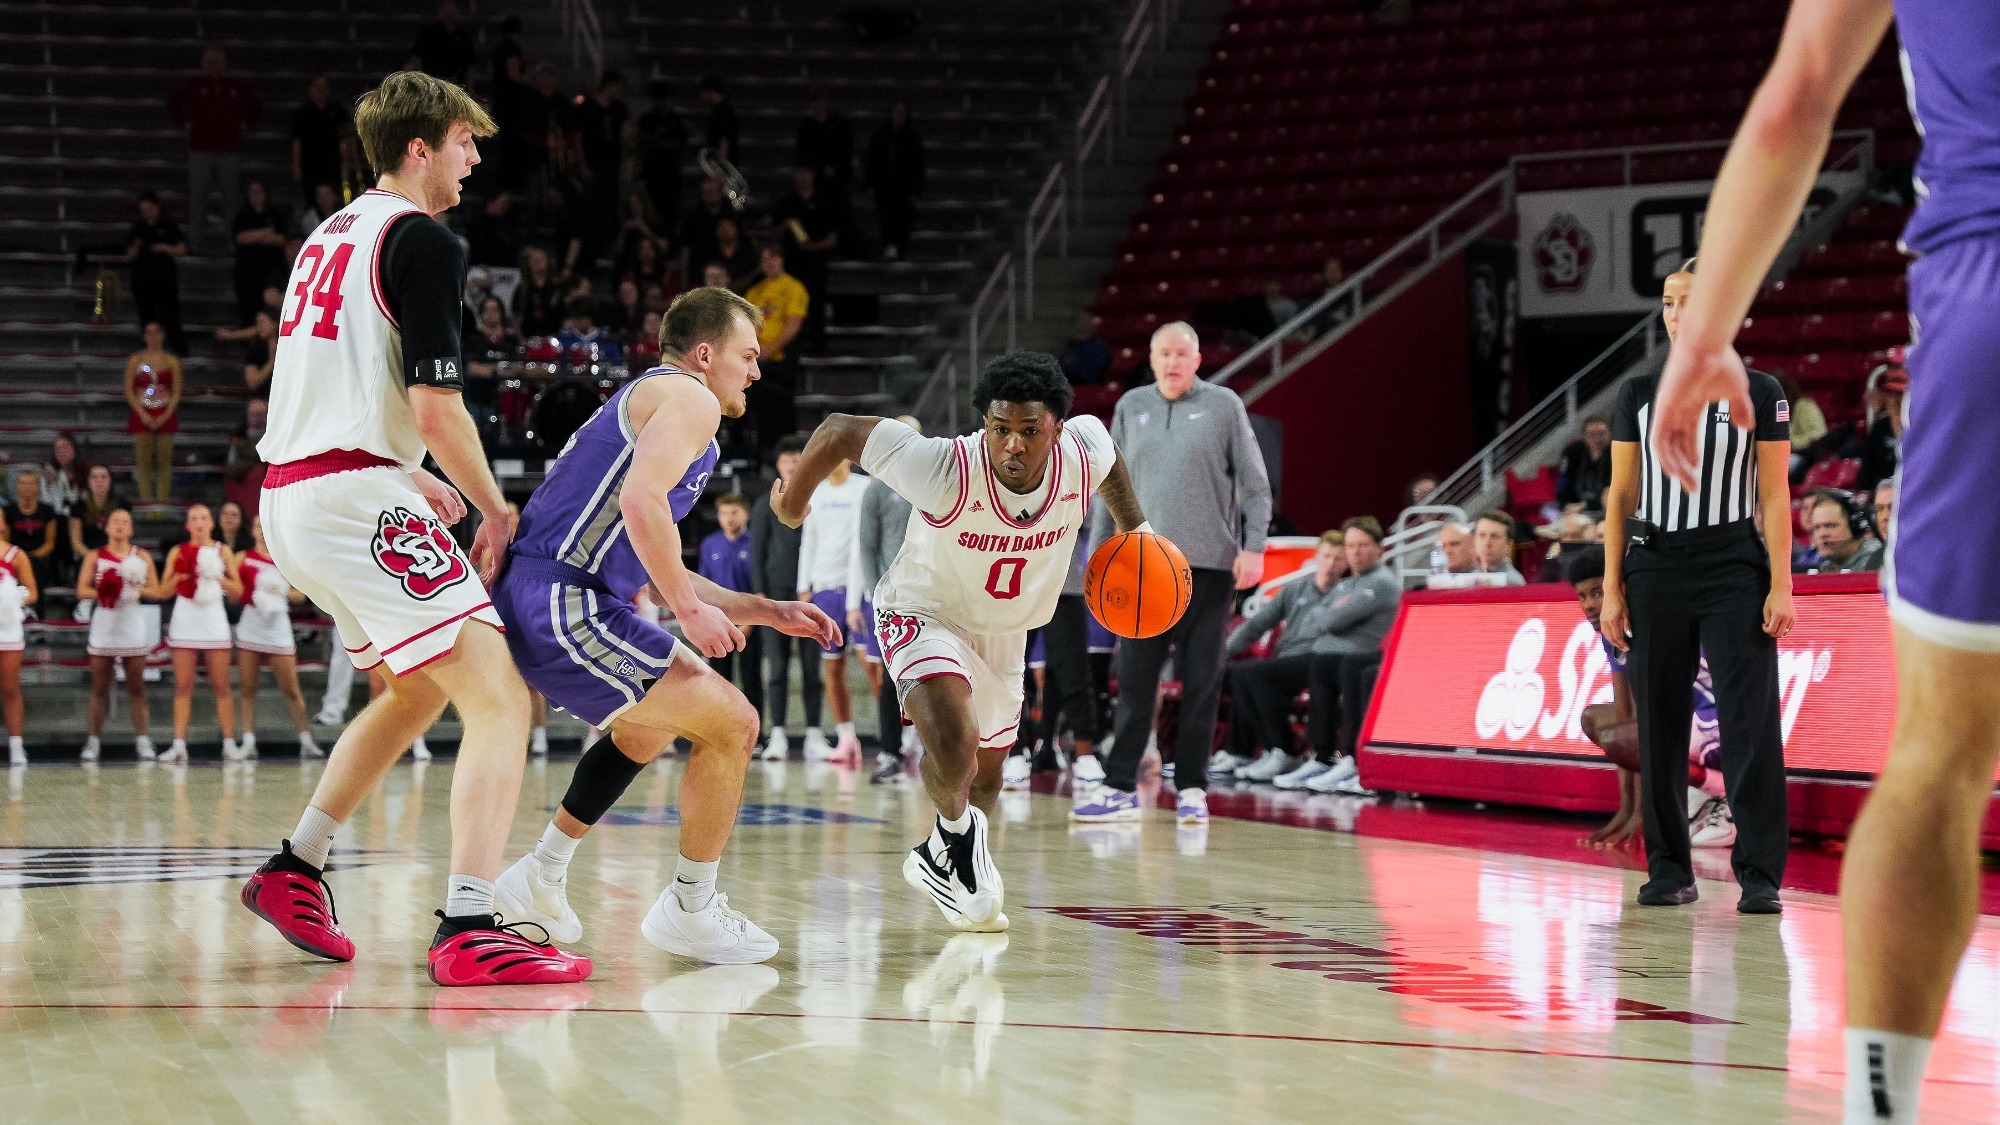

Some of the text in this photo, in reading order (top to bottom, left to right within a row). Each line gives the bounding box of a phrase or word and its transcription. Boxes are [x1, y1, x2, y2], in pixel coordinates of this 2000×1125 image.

[280, 242, 356, 341] 34
[957, 523, 1070, 553] SOUTH DAKOT
[984, 557, 1029, 601] 0
